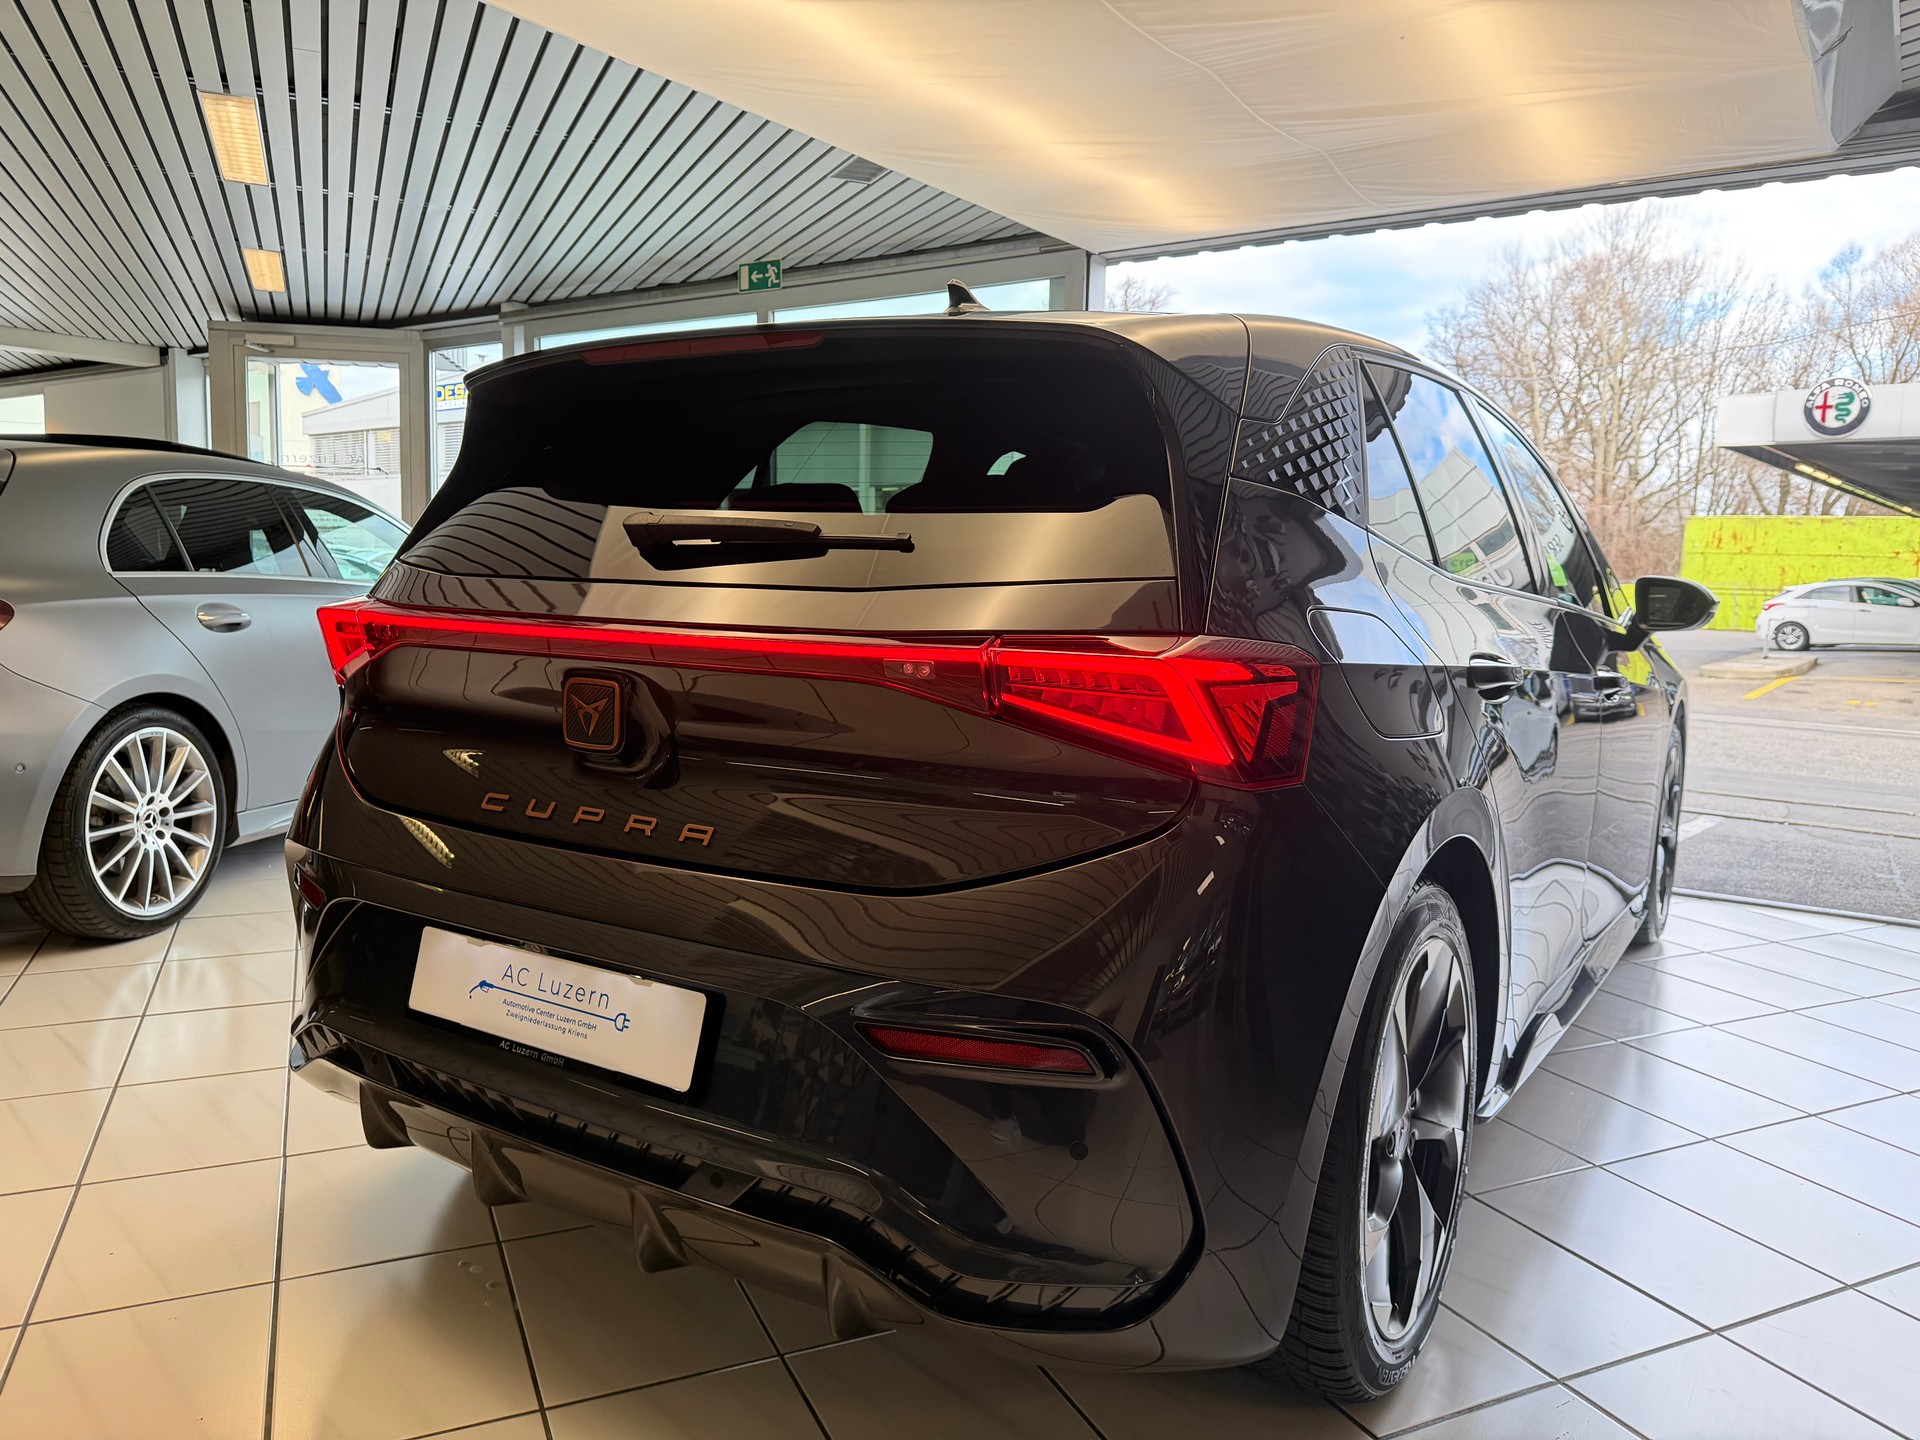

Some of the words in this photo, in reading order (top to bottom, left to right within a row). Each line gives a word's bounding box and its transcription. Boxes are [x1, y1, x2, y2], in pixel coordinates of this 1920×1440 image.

[436, 383, 467, 402] DES
[1806, 382, 1831, 408] ALFA
[1834, 378, 1869, 408] ROMEO
[480, 792, 715, 846] CUPRA
[501, 963, 530, 987] AC
[537, 972, 610, 1010] Luzern
[502, 998, 535, 1013] Automotive
[535, 1008, 556, 1020] Center
[556, 1014, 577, 1026] Luzern
[577, 1019, 598, 1032] GmbH
[505, 1009, 566, 1034] Zweigniederlassung
[567, 1027, 588, 1040] Kriens
[499, 1040, 511, 1050] AC
[511, 1043, 539, 1059] Luzern
[540, 1052, 565, 1067] GmbH
